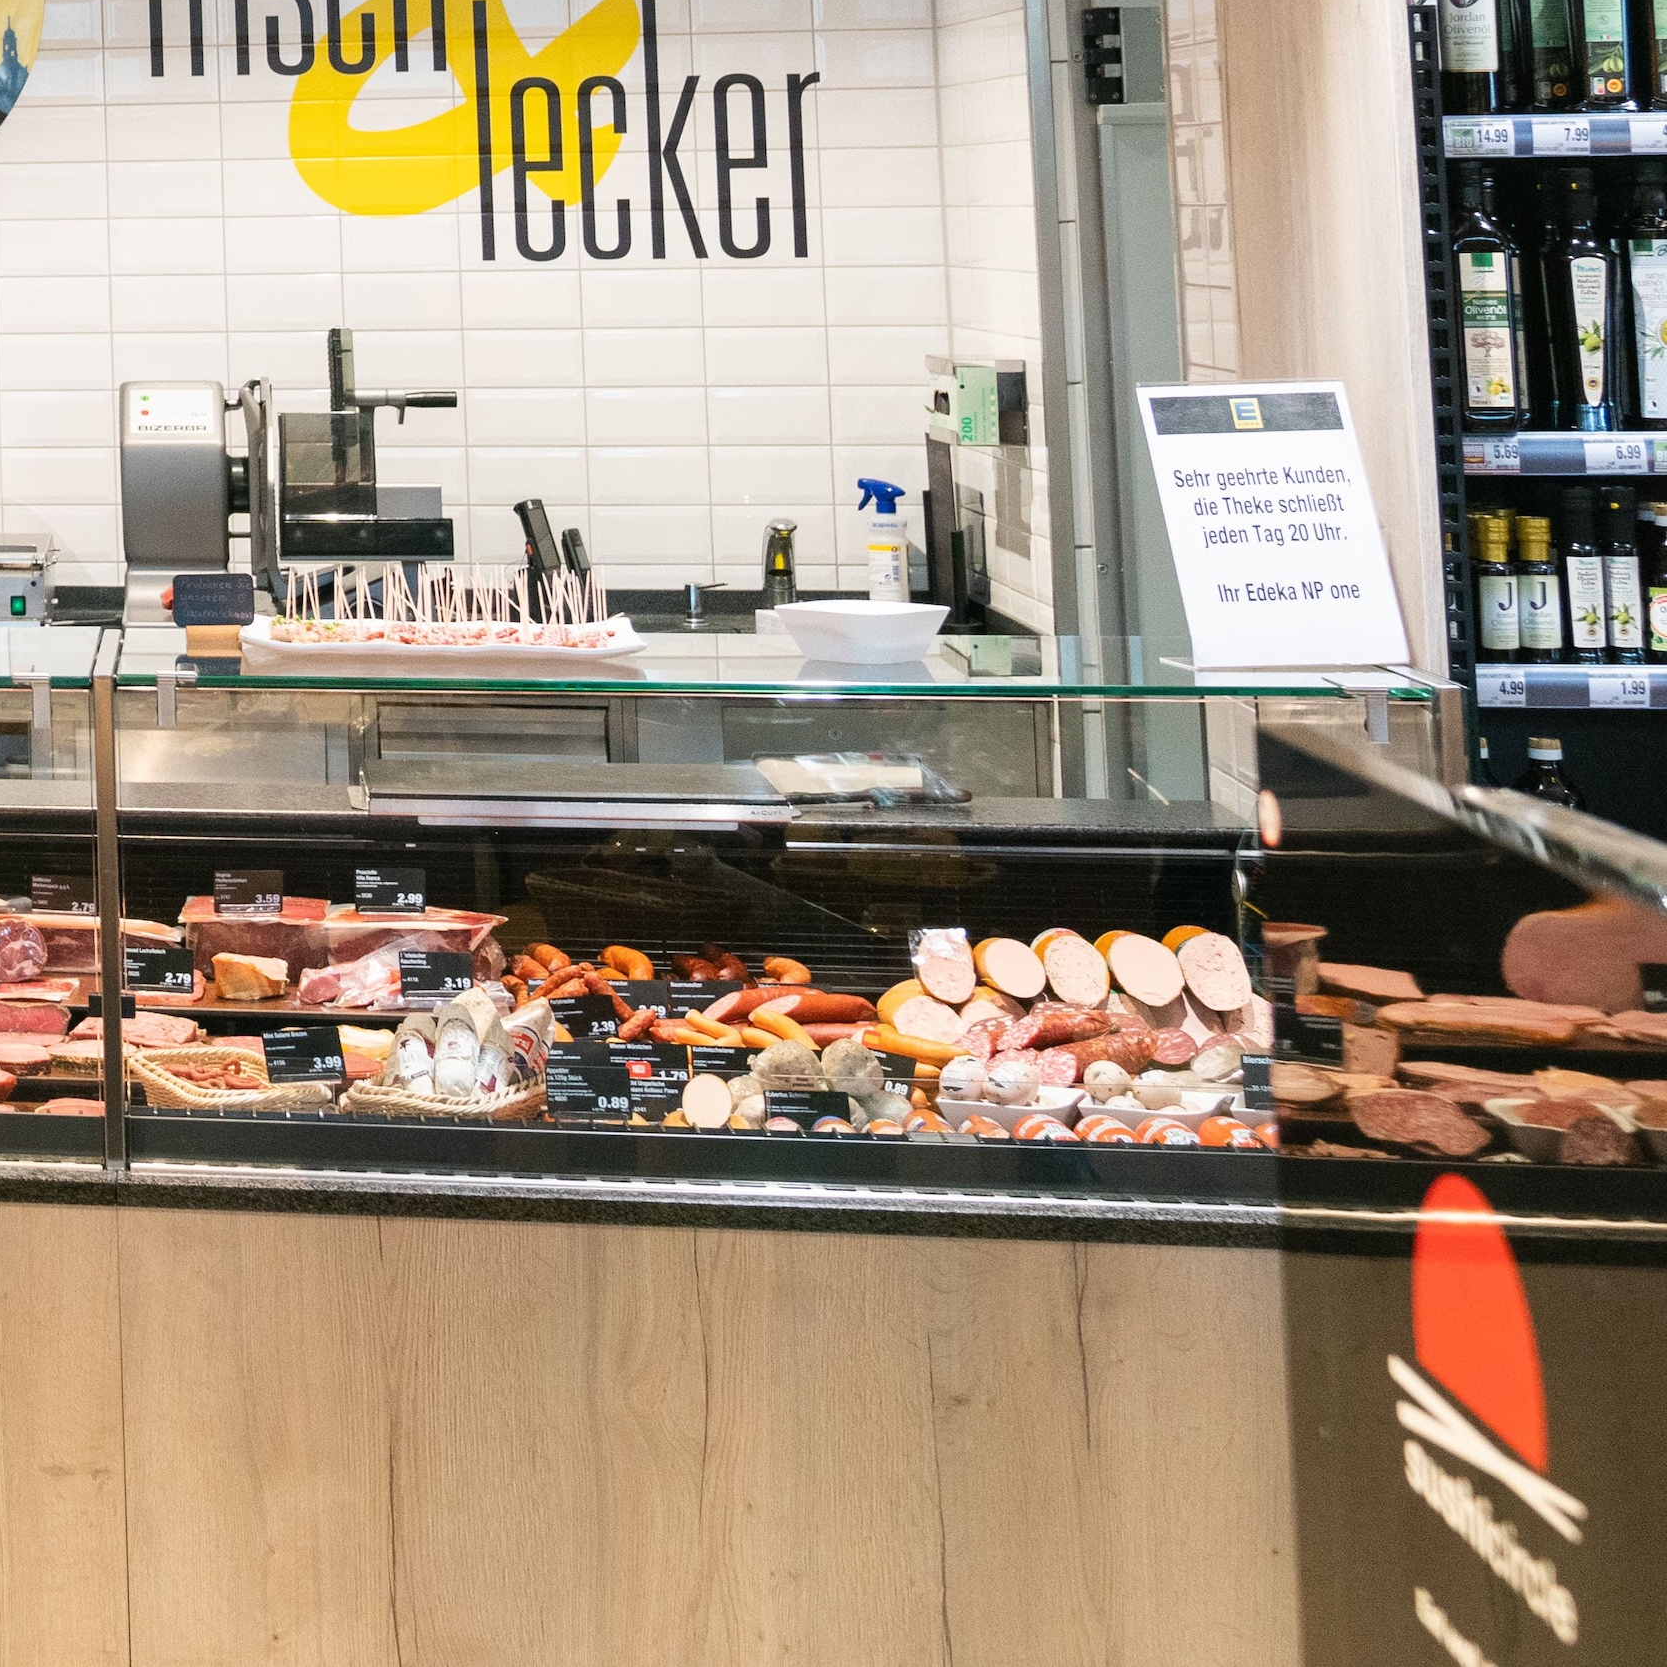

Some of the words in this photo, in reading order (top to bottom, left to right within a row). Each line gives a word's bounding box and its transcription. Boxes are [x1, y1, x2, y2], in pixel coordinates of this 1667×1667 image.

[1448, 12, 1485, 23] Jordan
[1444, 24, 1490, 34] Olivenöl
[1477, 129, 1508, 143] 14.99
[1564, 128, 1589, 142] 7.99
[1454, 137, 1474, 148] BIO
[1465, 305, 1507, 315] Olivenöl
[1235, 401, 1257, 421] E
[961, 417, 972, 442] 200
[1494, 445, 1518, 459] 5.69
[1617, 446, 1640, 459] 6.99
[1173, 469, 1210, 489] Sehr
[1217, 468, 1279, 491] geehrte
[1283, 466, 1351, 486] Kunden,
[1194, 498, 1218, 517] die
[1222, 496, 1274, 515] Theke
[1278, 494, 1345, 514] schließt
[1203, 526, 1249, 549] jeden
[1252, 524, 1284, 546] Tag
[1288, 523, 1309, 542] 20
[1313, 522, 1348, 542] Uhr.
[1218, 583, 1240, 603] Ihr
[1246, 582, 1298, 602] Edeka
[1302, 581, 1324, 600] NP
[1330, 583, 1360, 600] one
[1499, 681, 1524, 695] 4.99
[1621, 681, 1645, 694] 1.99
[255, 894, 280, 904] 3.59
[397, 894, 423, 904] 2.99
[71, 902, 95, 912] 2.79
[165, 973, 191, 983] 2.79
[444, 977, 471, 988] 3.19
[592, 1021, 615, 1032] 2.39
[313, 1056, 342, 1068] 3.99
[1243, 1056, 1270, 1065] Biersch
[632, 1065, 645, 1073] NEU
[659, 1071, 687, 1080] 1.79
[884, 1080, 909, 1095] 0.89
[597, 1097, 629, 1108] 0.89
